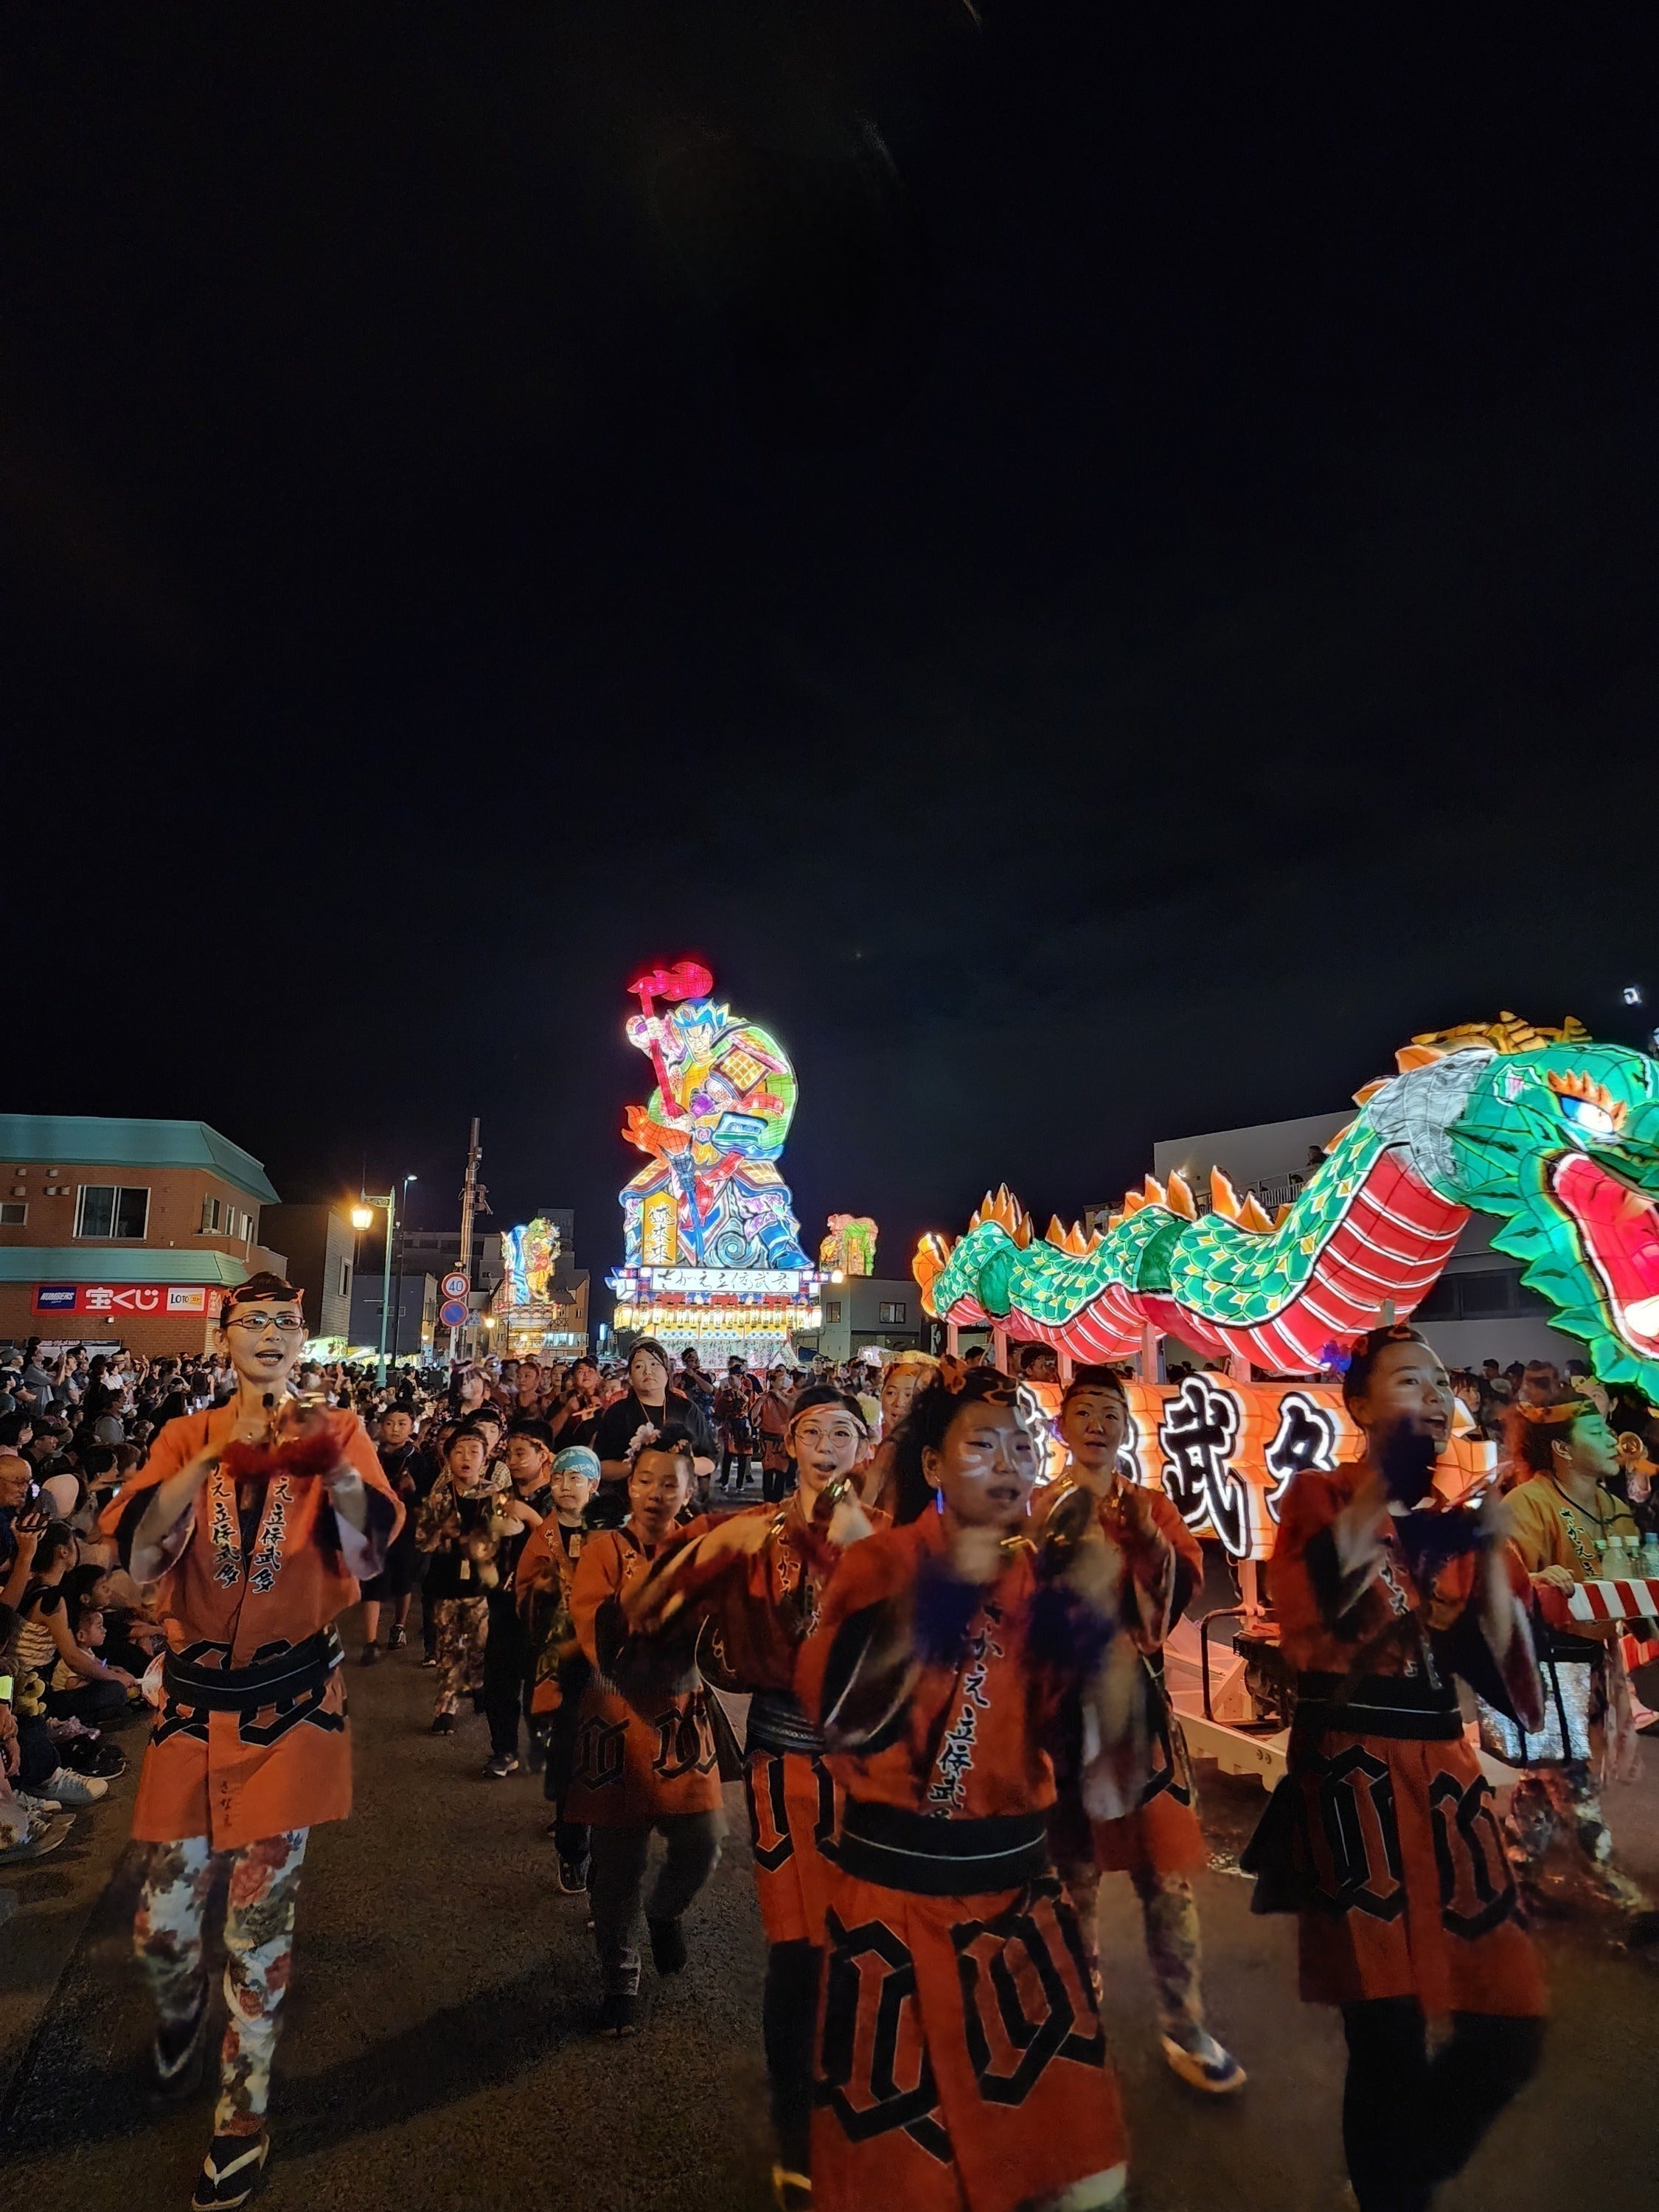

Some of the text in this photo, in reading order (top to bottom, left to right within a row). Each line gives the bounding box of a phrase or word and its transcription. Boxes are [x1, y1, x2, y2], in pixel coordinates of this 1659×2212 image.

[448, 1280, 464, 1293] 40
[40, 1292, 75, 1301] NUMBERS
[85, 1287, 159, 1310] 宝くじ
[170, 1293, 189, 1304] LOTO
[209, 1290, 223, 1312] 宝く
